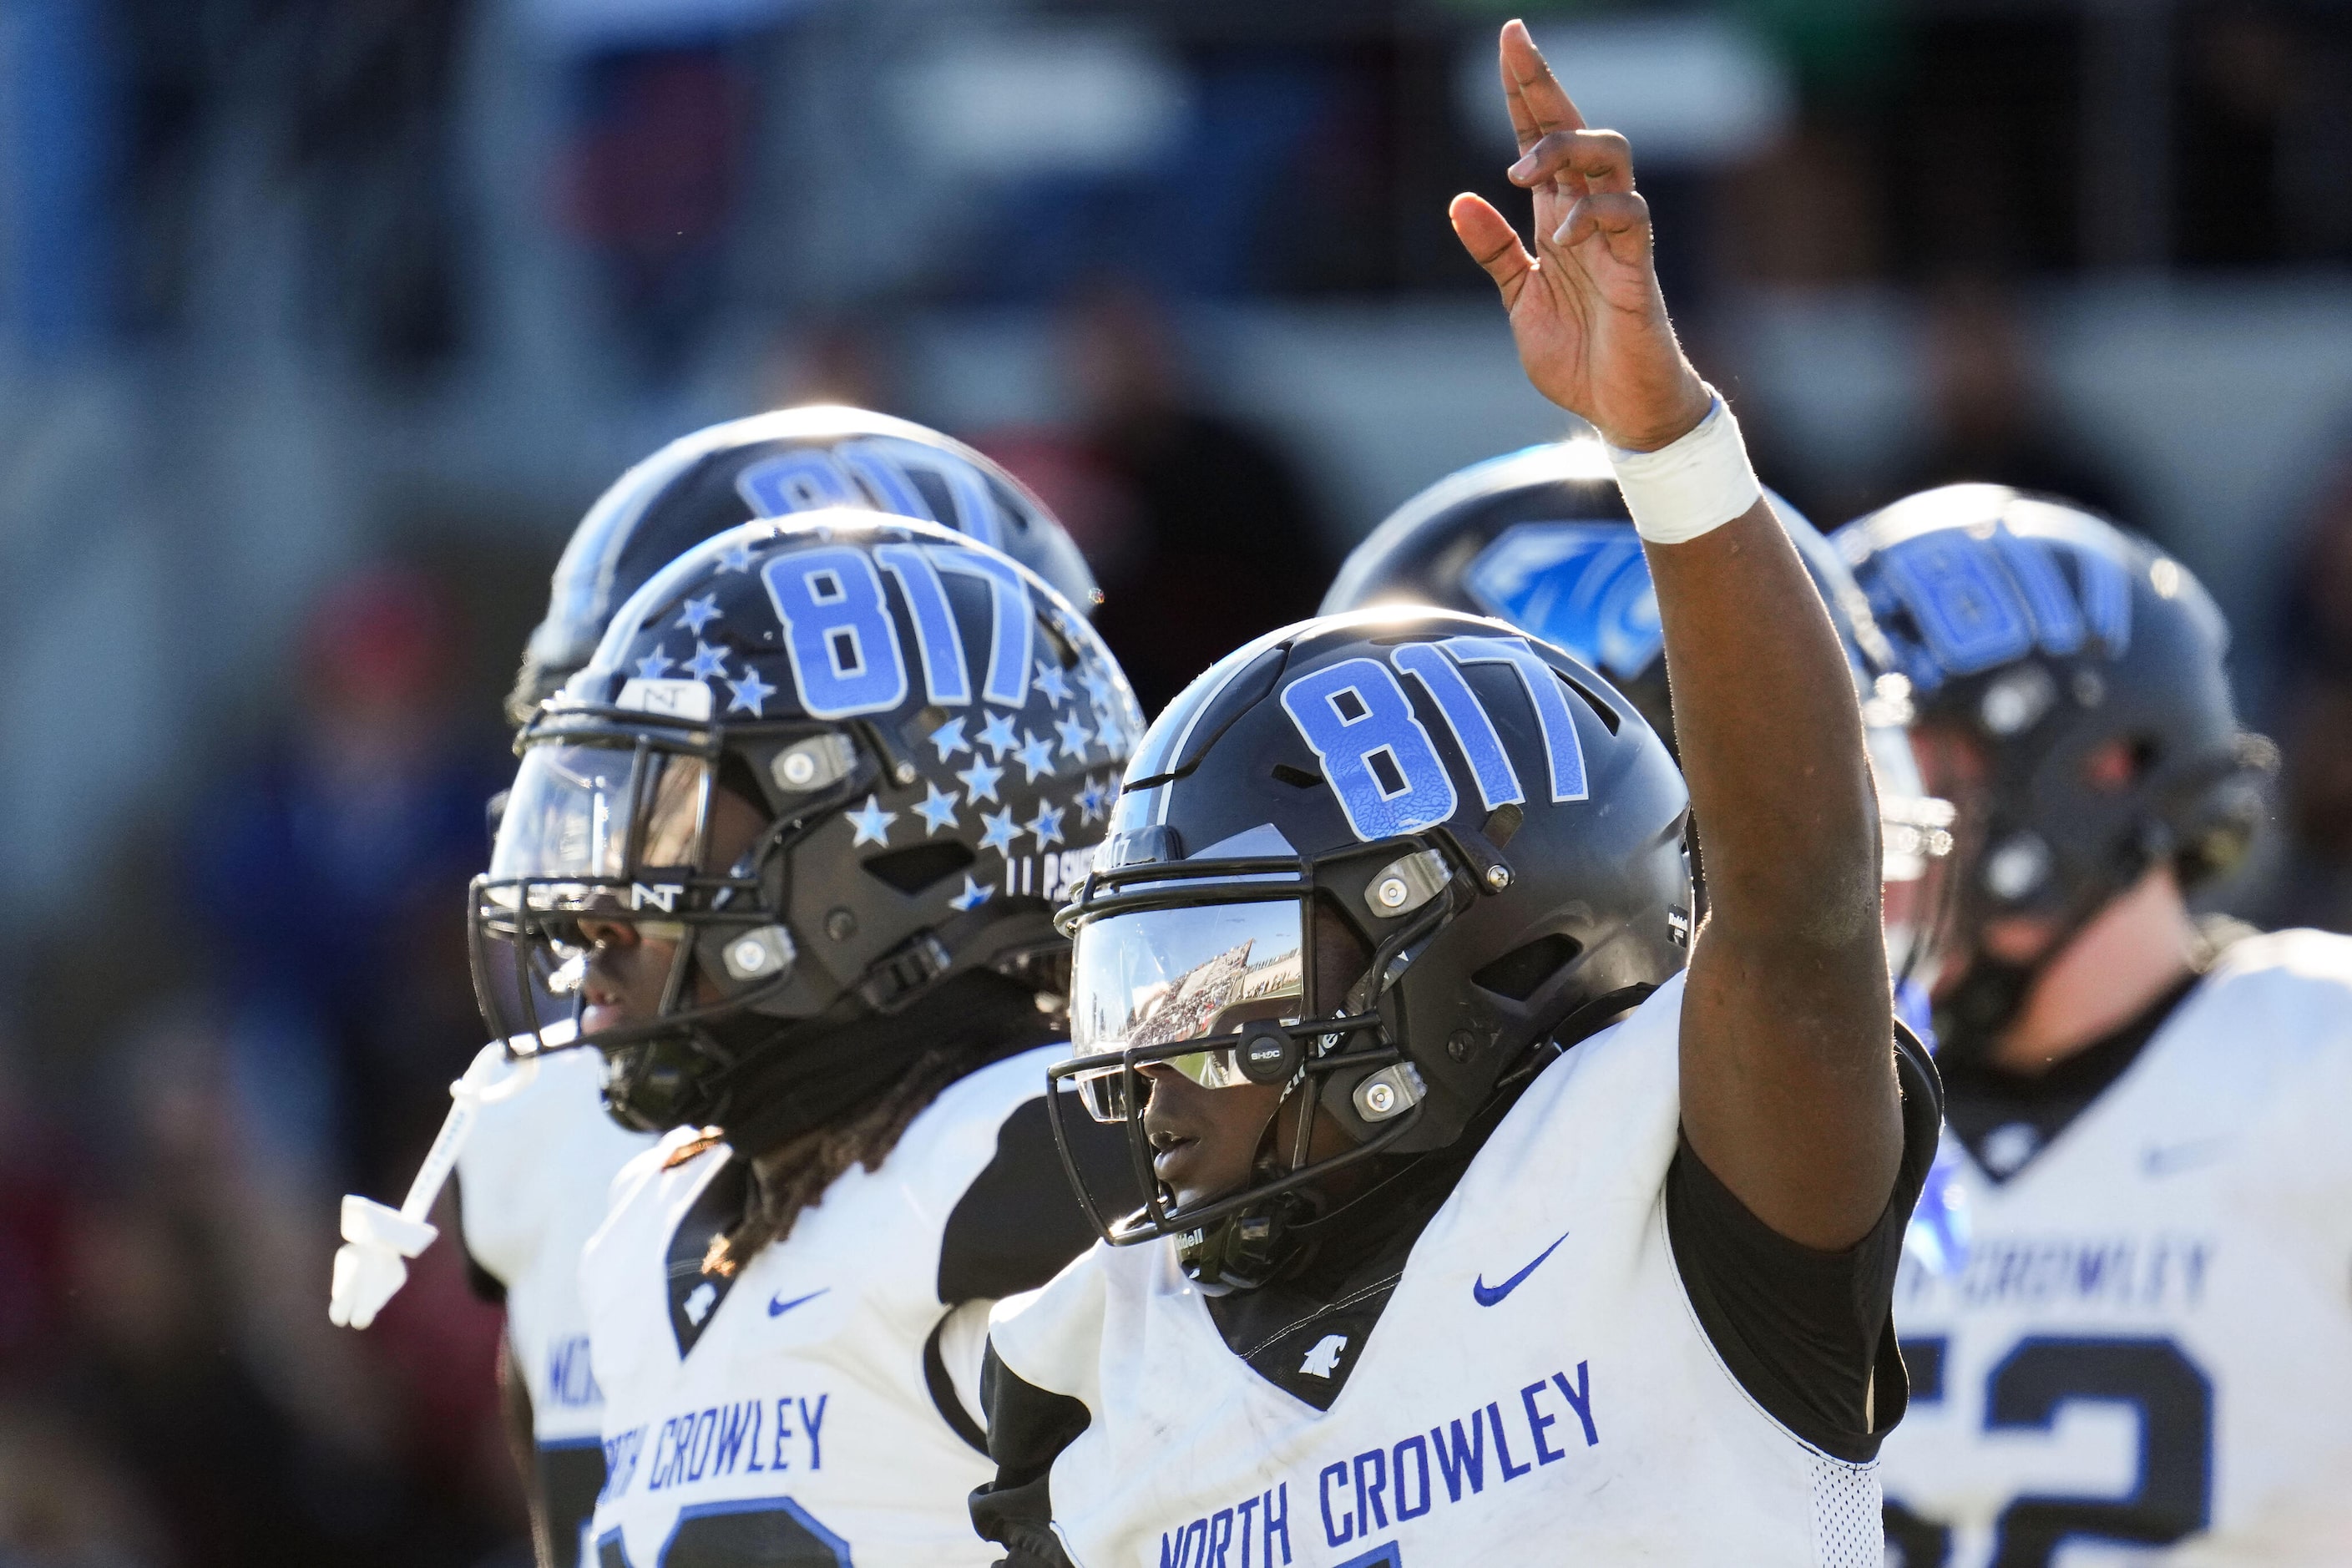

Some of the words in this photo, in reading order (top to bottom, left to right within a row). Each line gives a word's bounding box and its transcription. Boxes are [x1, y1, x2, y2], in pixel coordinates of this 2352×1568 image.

[761, 544, 1034, 721] 817
[1280, 635, 1589, 842] 817
[1251, 1050, 1280, 1060] SHOC
[648, 1393, 828, 1491] CROWLEY
[1159, 1481, 1292, 1568] NORTH
[1319, 1359, 1600, 1549] CROWLEY
